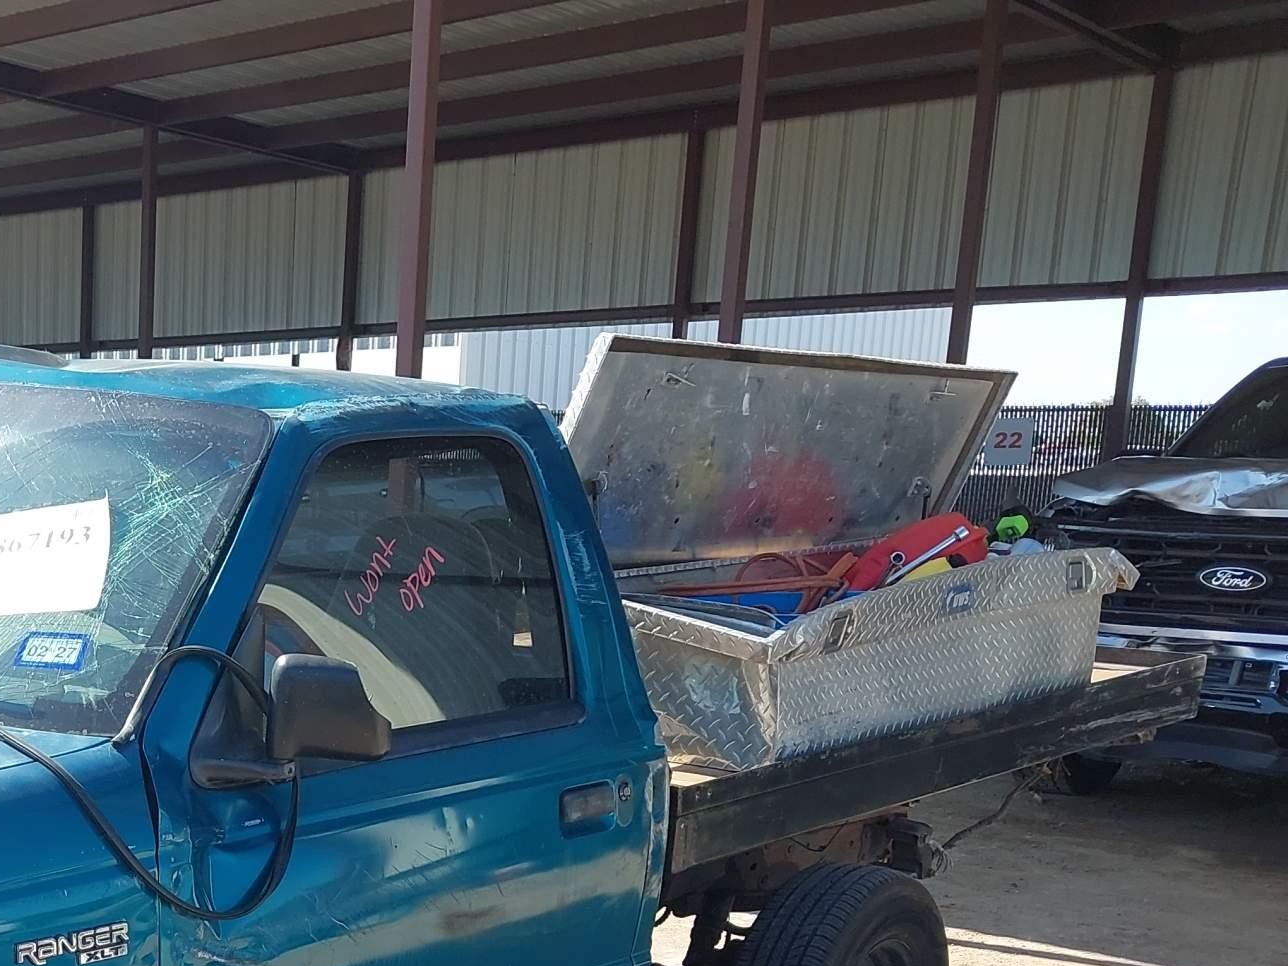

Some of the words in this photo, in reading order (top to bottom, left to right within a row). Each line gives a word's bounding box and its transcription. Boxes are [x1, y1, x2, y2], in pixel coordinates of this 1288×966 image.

[993, 431, 1023, 449] 22
[1211, 569, 1254, 588] Ford
[26, 644, 49, 658] 02
[54, 646, 78, 659] 27
[84, 944, 126, 963] XLT
